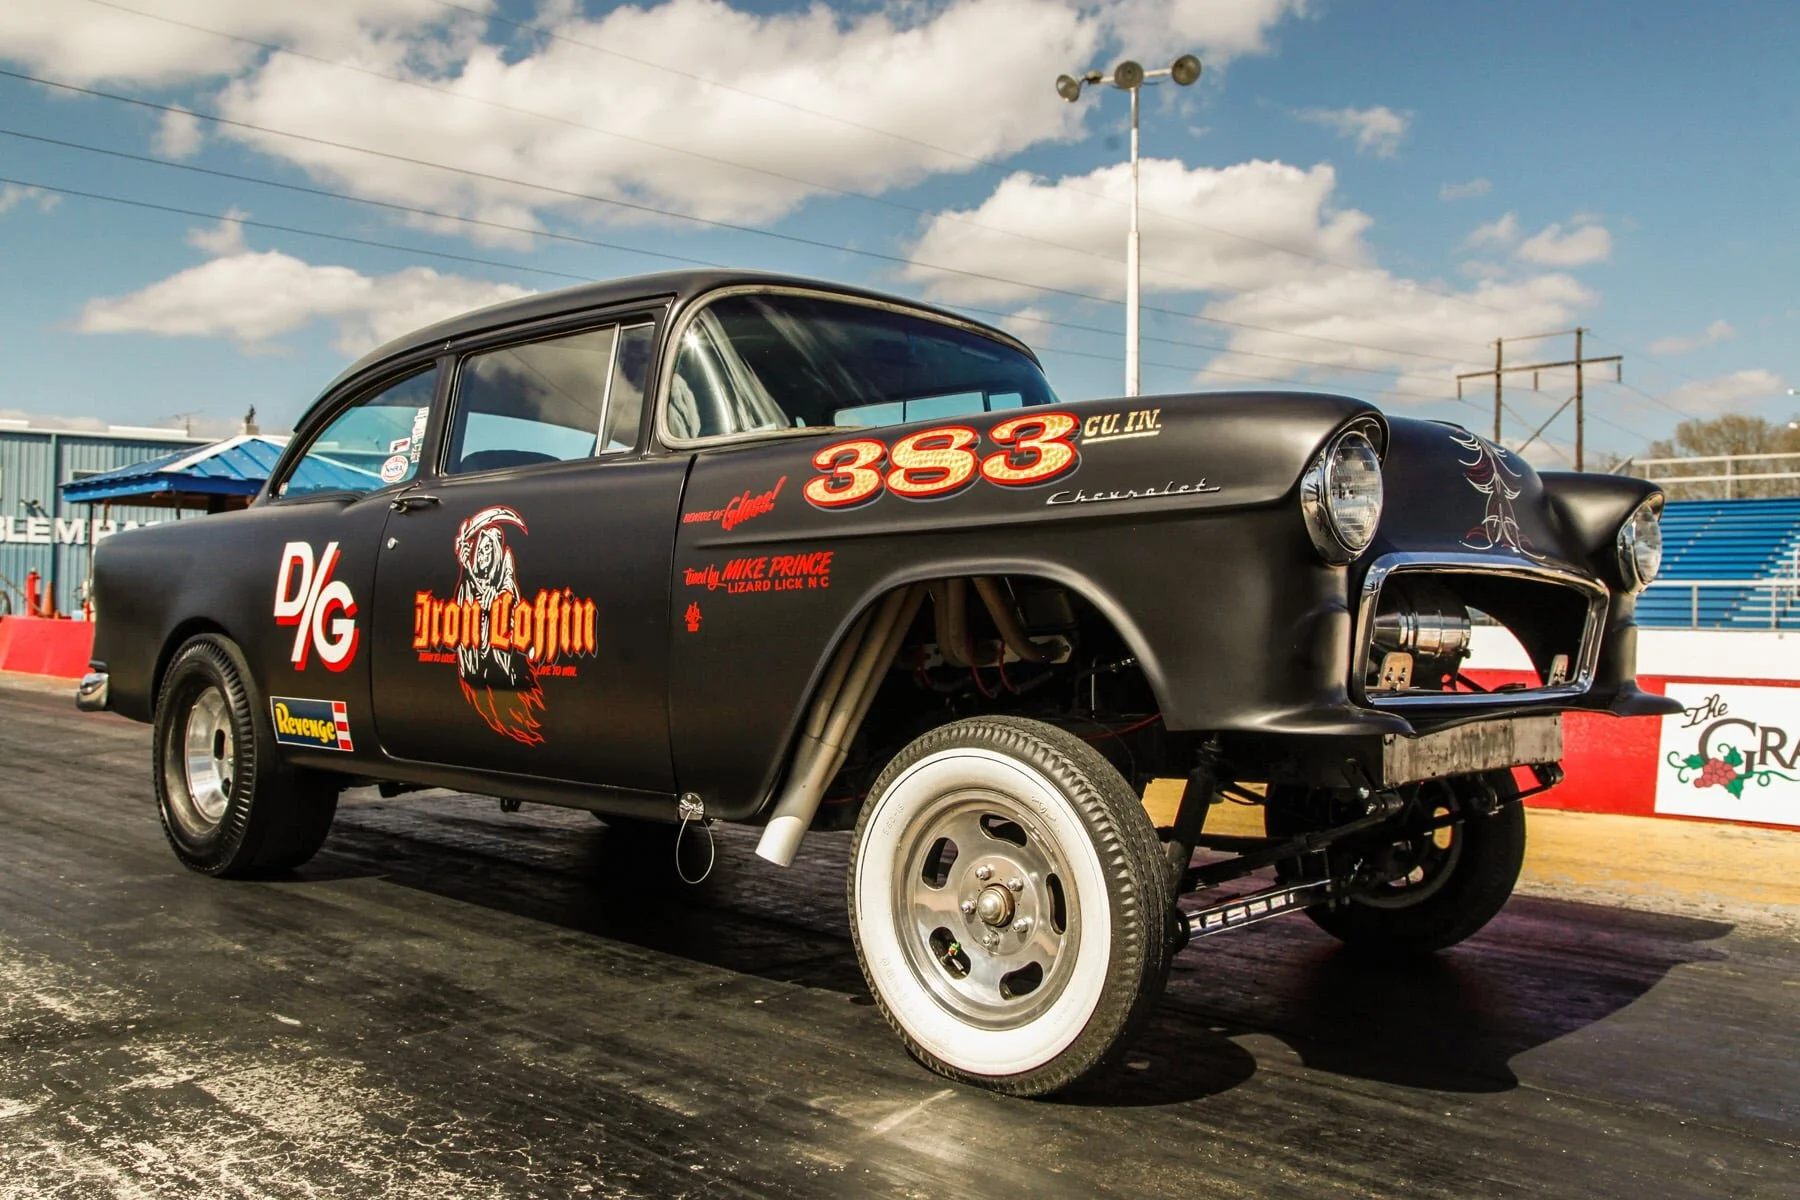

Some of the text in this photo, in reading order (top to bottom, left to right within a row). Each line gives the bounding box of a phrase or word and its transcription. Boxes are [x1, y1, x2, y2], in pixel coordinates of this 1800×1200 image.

[803, 411, 1081, 508] 383
[1124, 409, 1162, 432] IN.
[683, 475, 788, 531] BEWARE OF Glass!
[1046, 478, 1221, 505] Chevrolet
[722, 557, 768, 580] MIKE
[769, 552, 834, 577] PRINCE
[728, 576, 829, 593] LIZARD LICK N C
[273, 541, 358, 672] D/G
[412, 584, 597, 663] Iron Coffin
[551, 666, 562, 676] TO
[274, 702, 336, 743] Revenge
[1681, 693, 1728, 728] The
